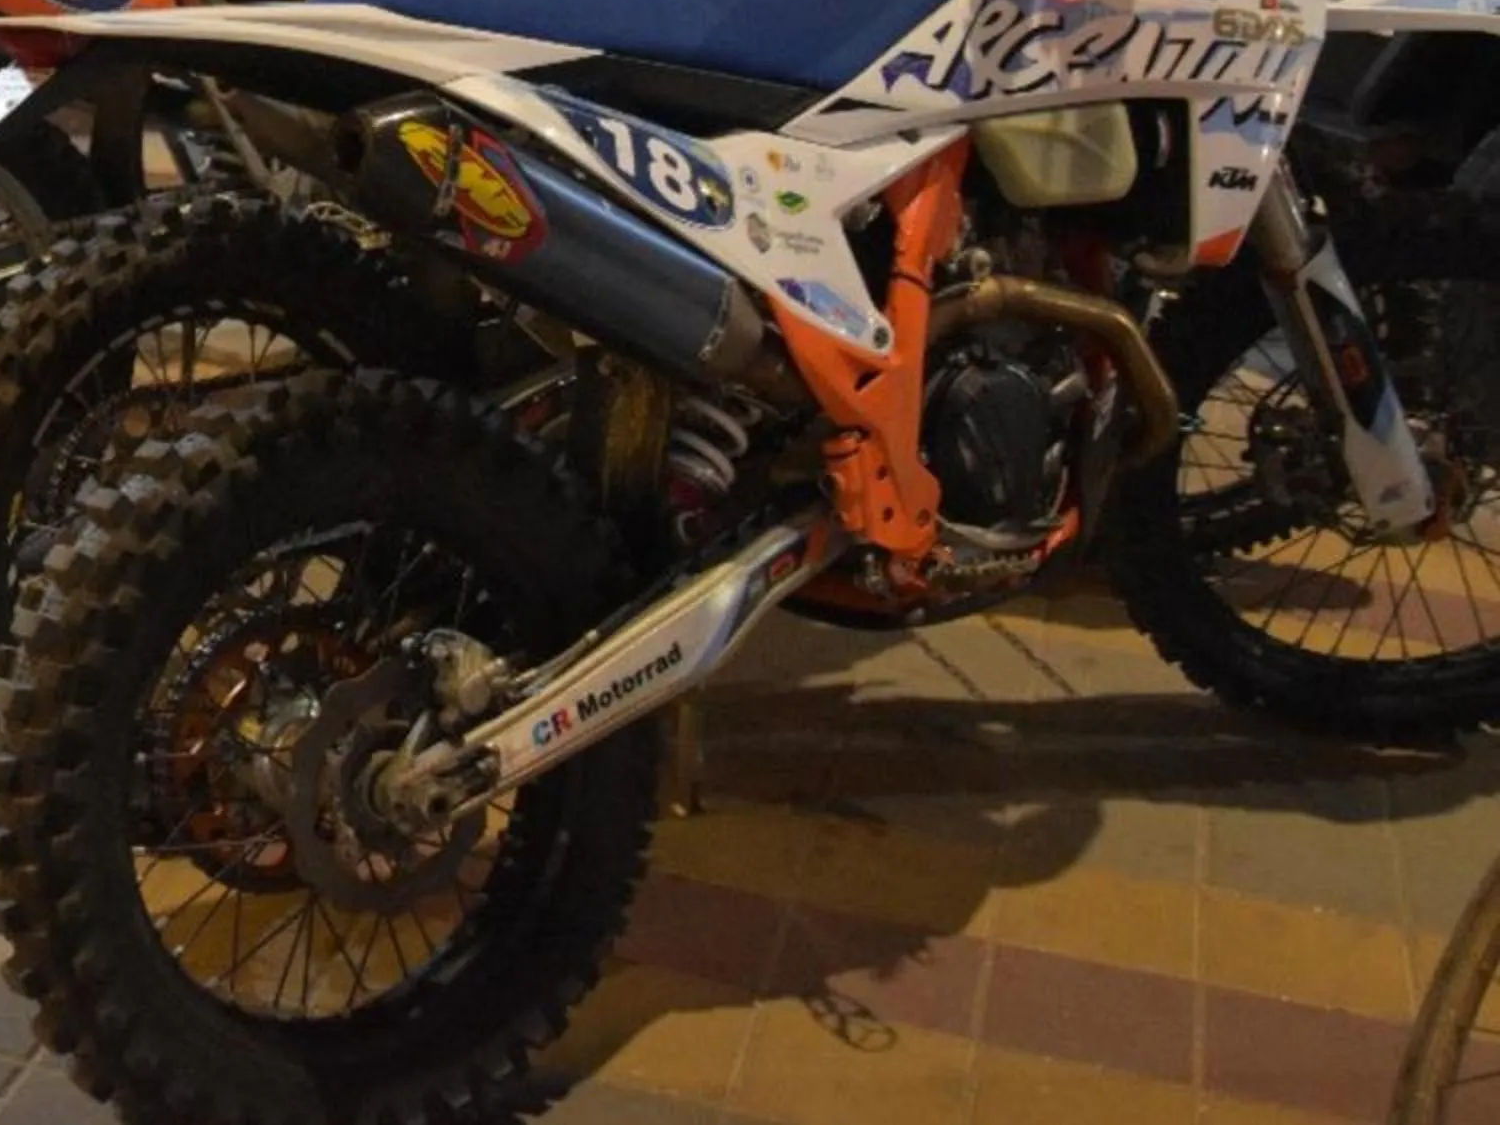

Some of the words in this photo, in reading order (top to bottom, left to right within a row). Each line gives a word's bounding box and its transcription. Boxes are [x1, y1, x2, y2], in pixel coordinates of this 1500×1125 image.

[596, 116, 698, 212] 18
[1208, 165, 1259, 192] KTM
[532, 708, 573, 746] CR
[576, 642, 683, 721] Motorrad
